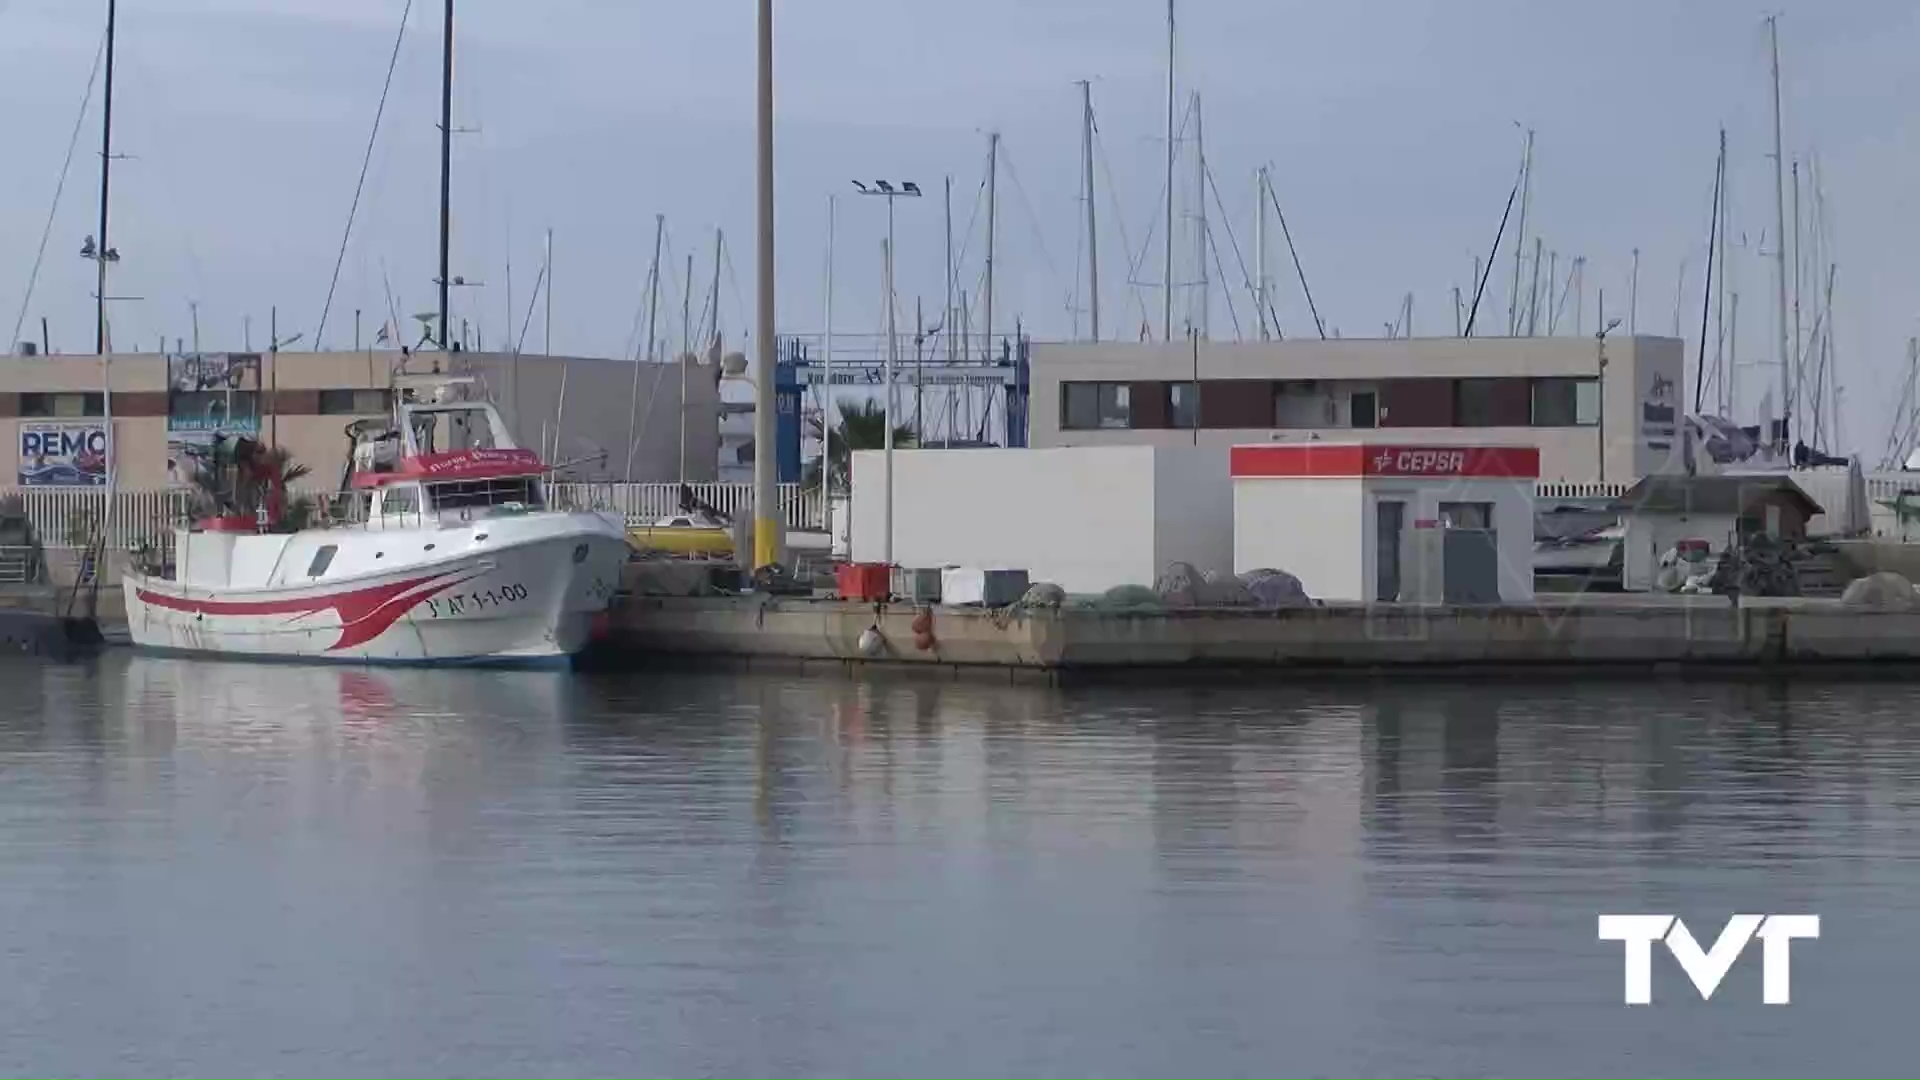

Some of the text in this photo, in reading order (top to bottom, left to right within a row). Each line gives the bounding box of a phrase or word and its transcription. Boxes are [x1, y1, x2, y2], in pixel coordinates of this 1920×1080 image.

[22, 431, 106, 456] REMO
[1397, 451, 1465, 473] CEPSA
[447, 594, 465, 616] AT
